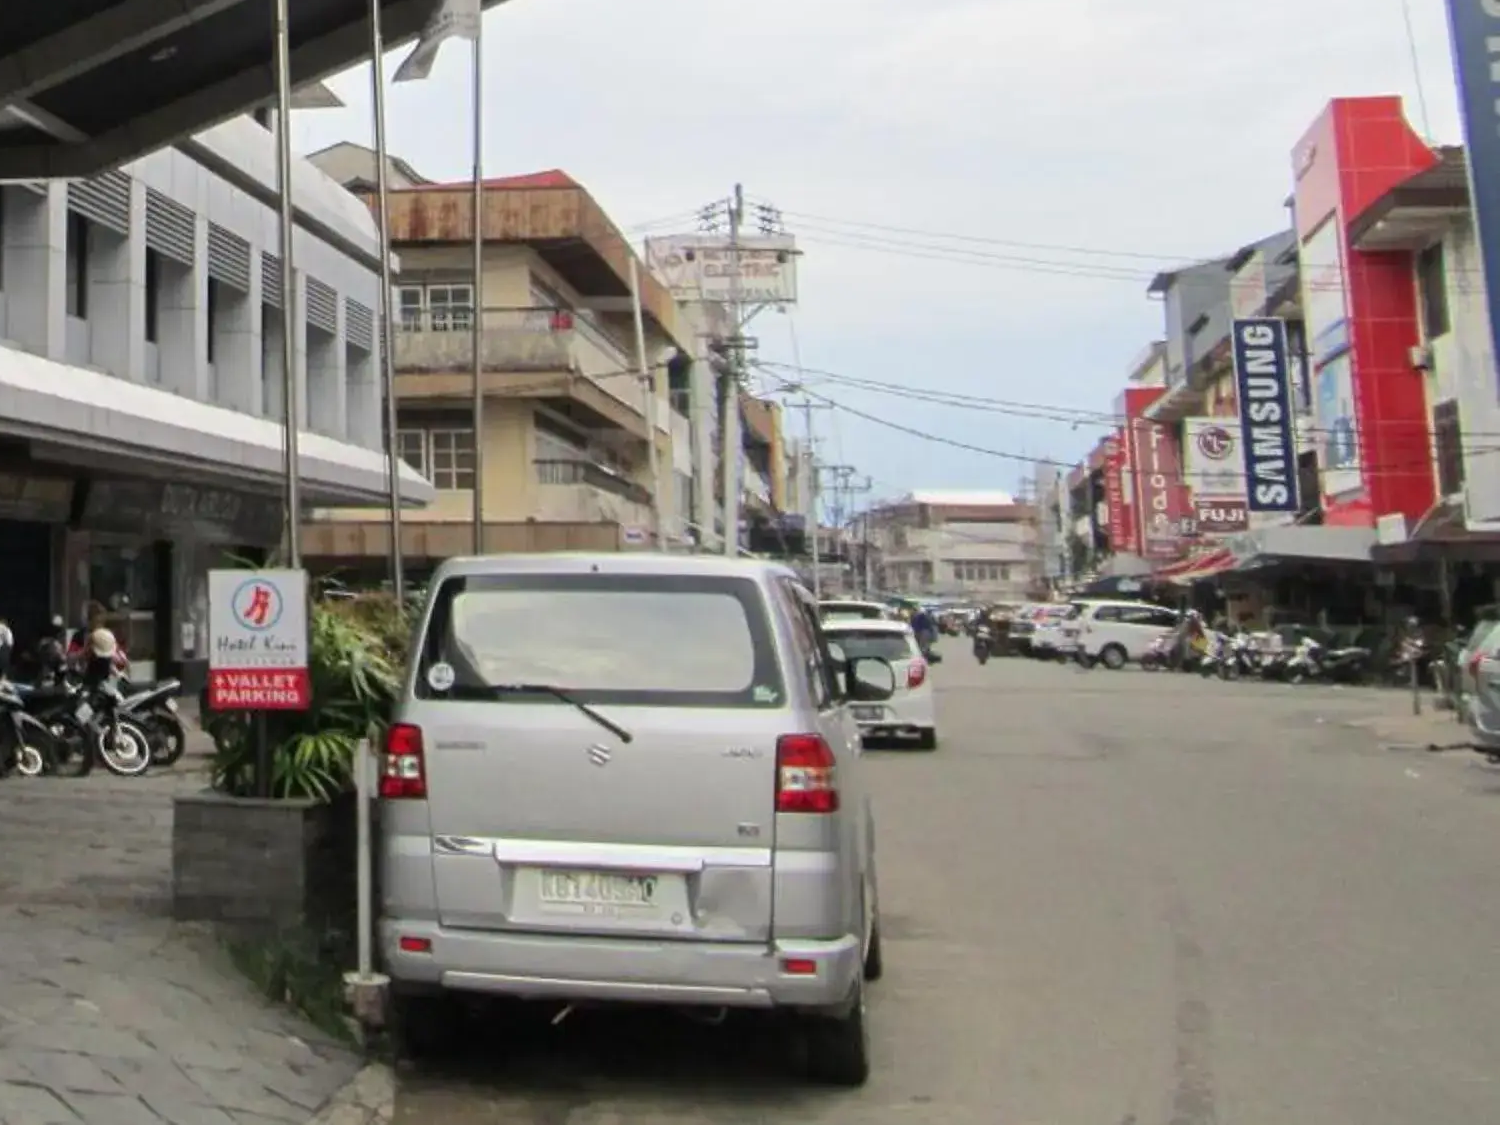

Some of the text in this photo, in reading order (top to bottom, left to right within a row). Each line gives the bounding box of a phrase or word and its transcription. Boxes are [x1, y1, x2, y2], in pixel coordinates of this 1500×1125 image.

[1243, 326, 1288, 505] SAMSUNG
[1200, 508, 1244, 522] FUJI
[216, 688, 300, 703] PARKING
